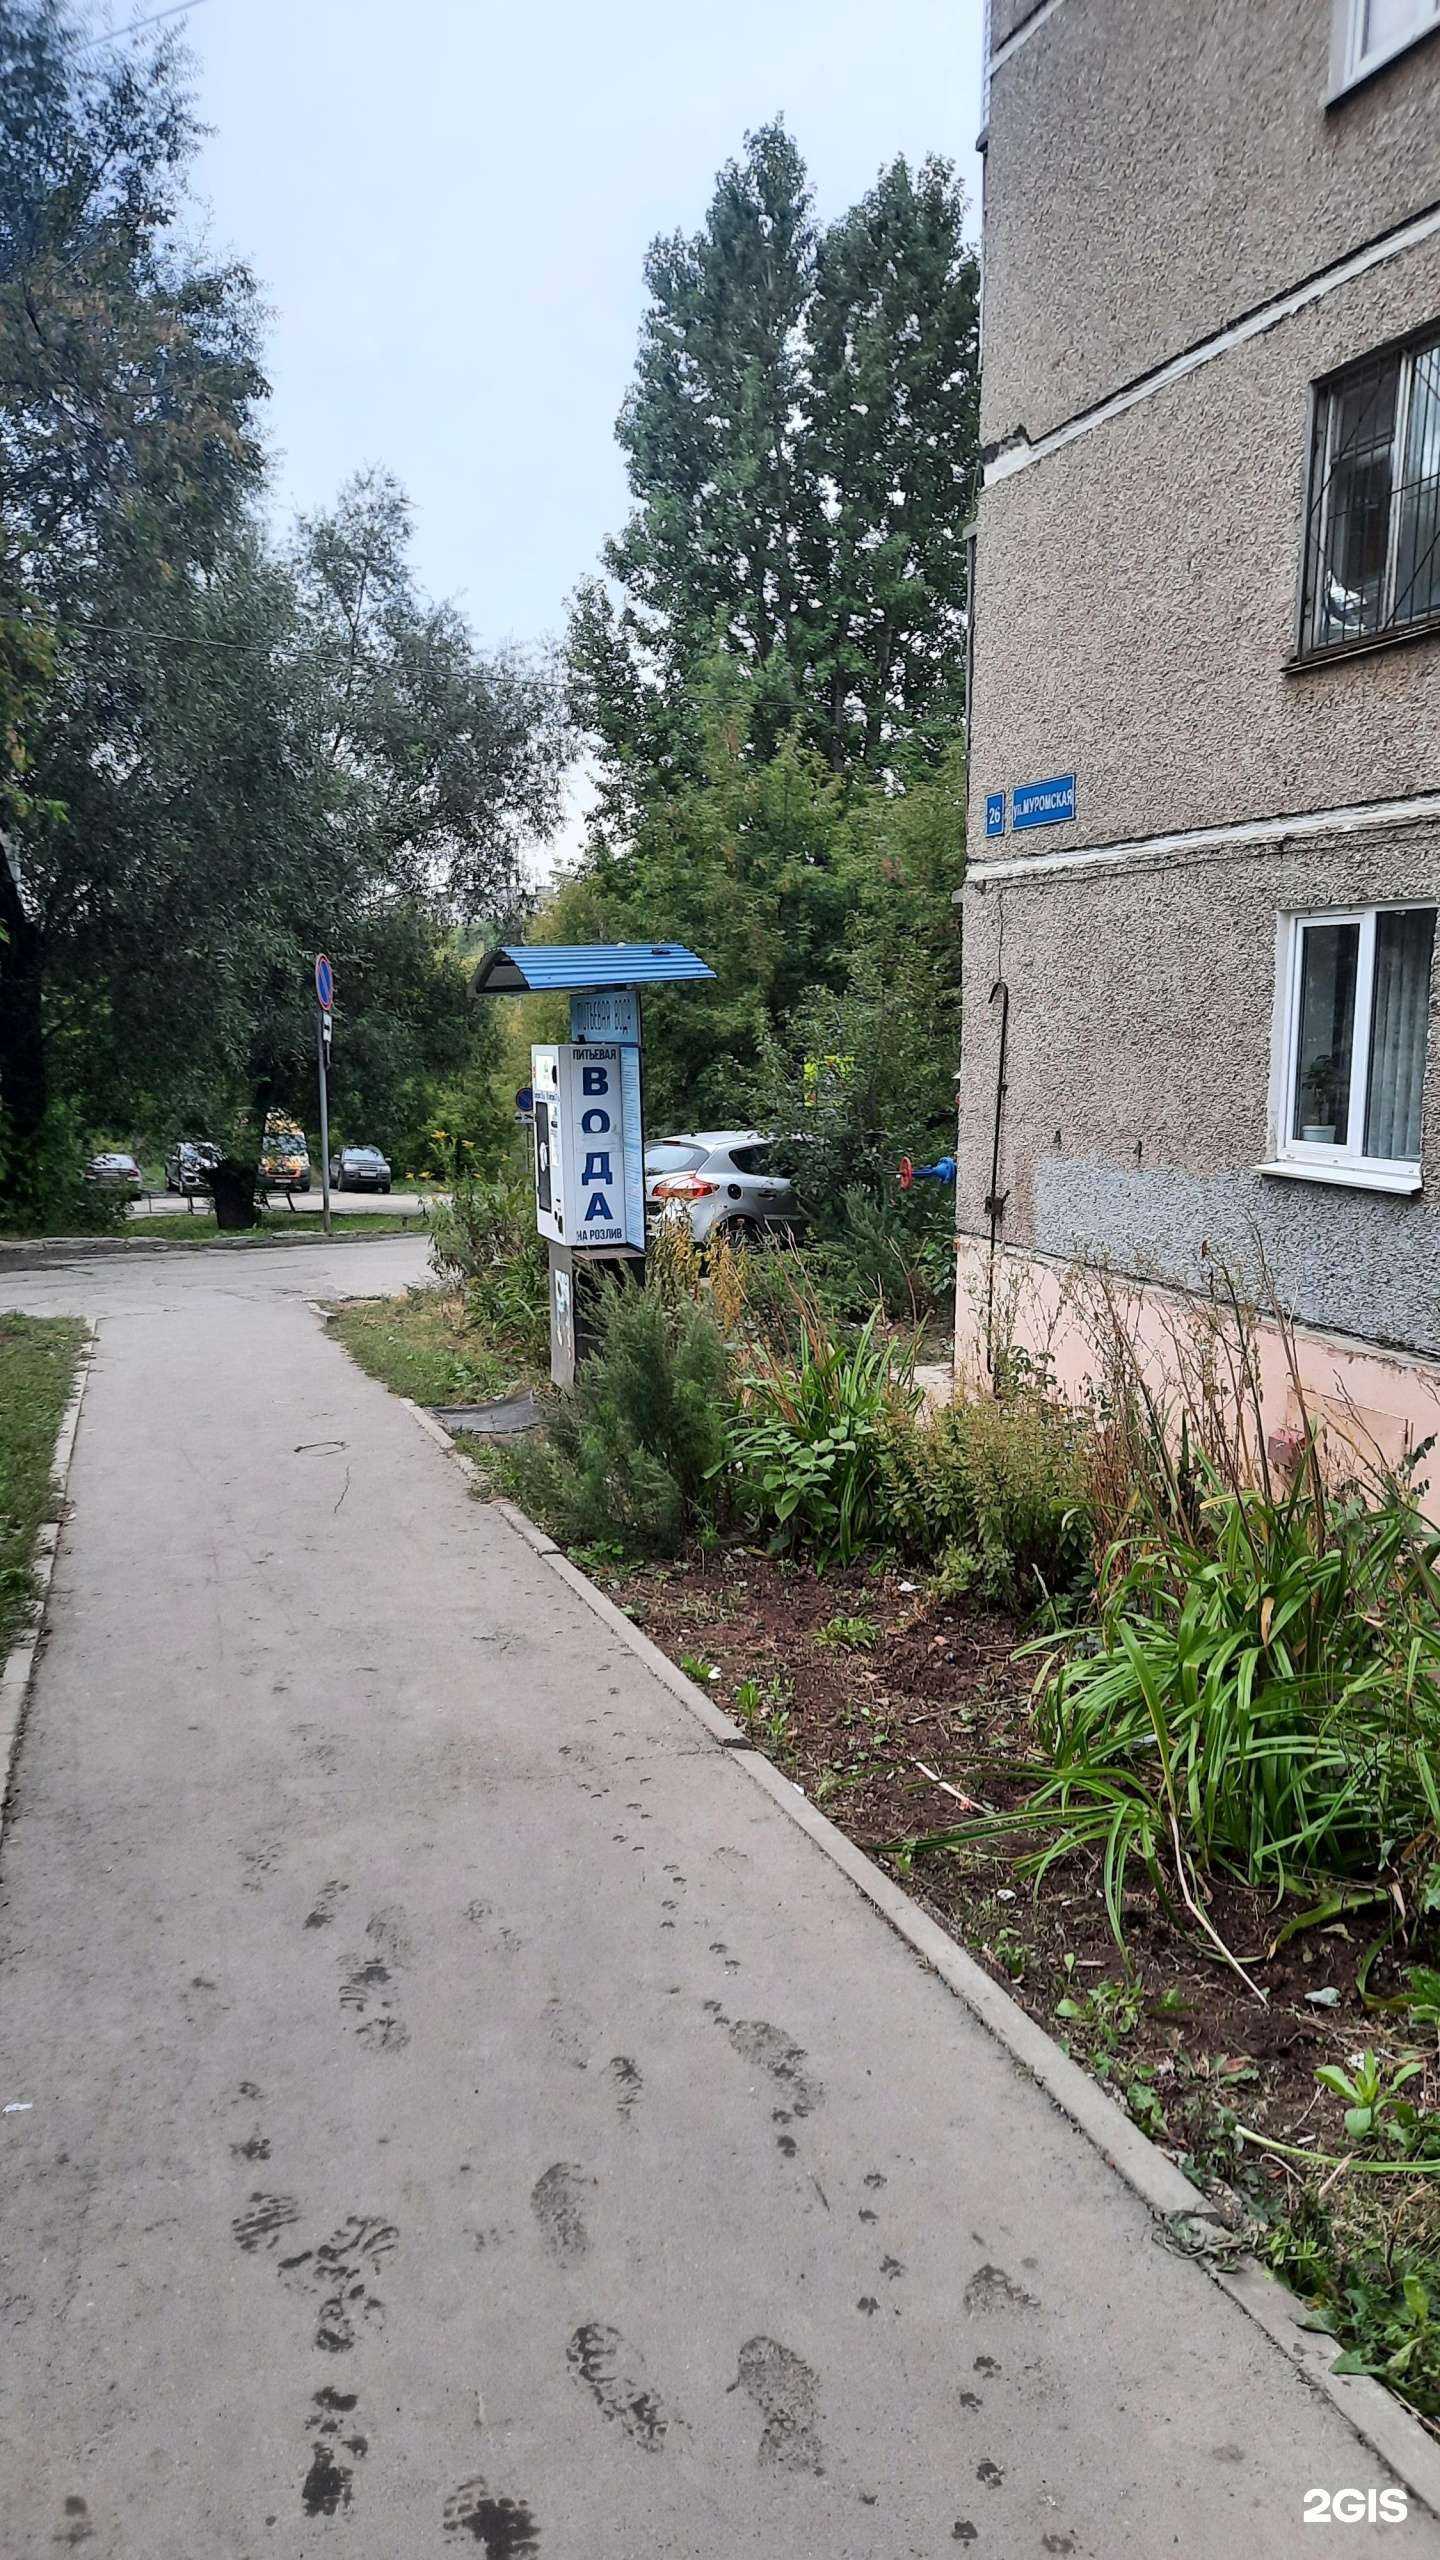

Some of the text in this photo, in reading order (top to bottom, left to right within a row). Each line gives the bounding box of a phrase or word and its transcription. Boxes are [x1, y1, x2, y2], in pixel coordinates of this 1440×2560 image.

[989, 806, 1001, 825] 26
[572, 1048, 617, 1061] ПИТЬЕВАЯ
[581, 1066, 614, 1222] ВОДА
[576, 1227, 623, 1241] НА РОЗЛИВ
